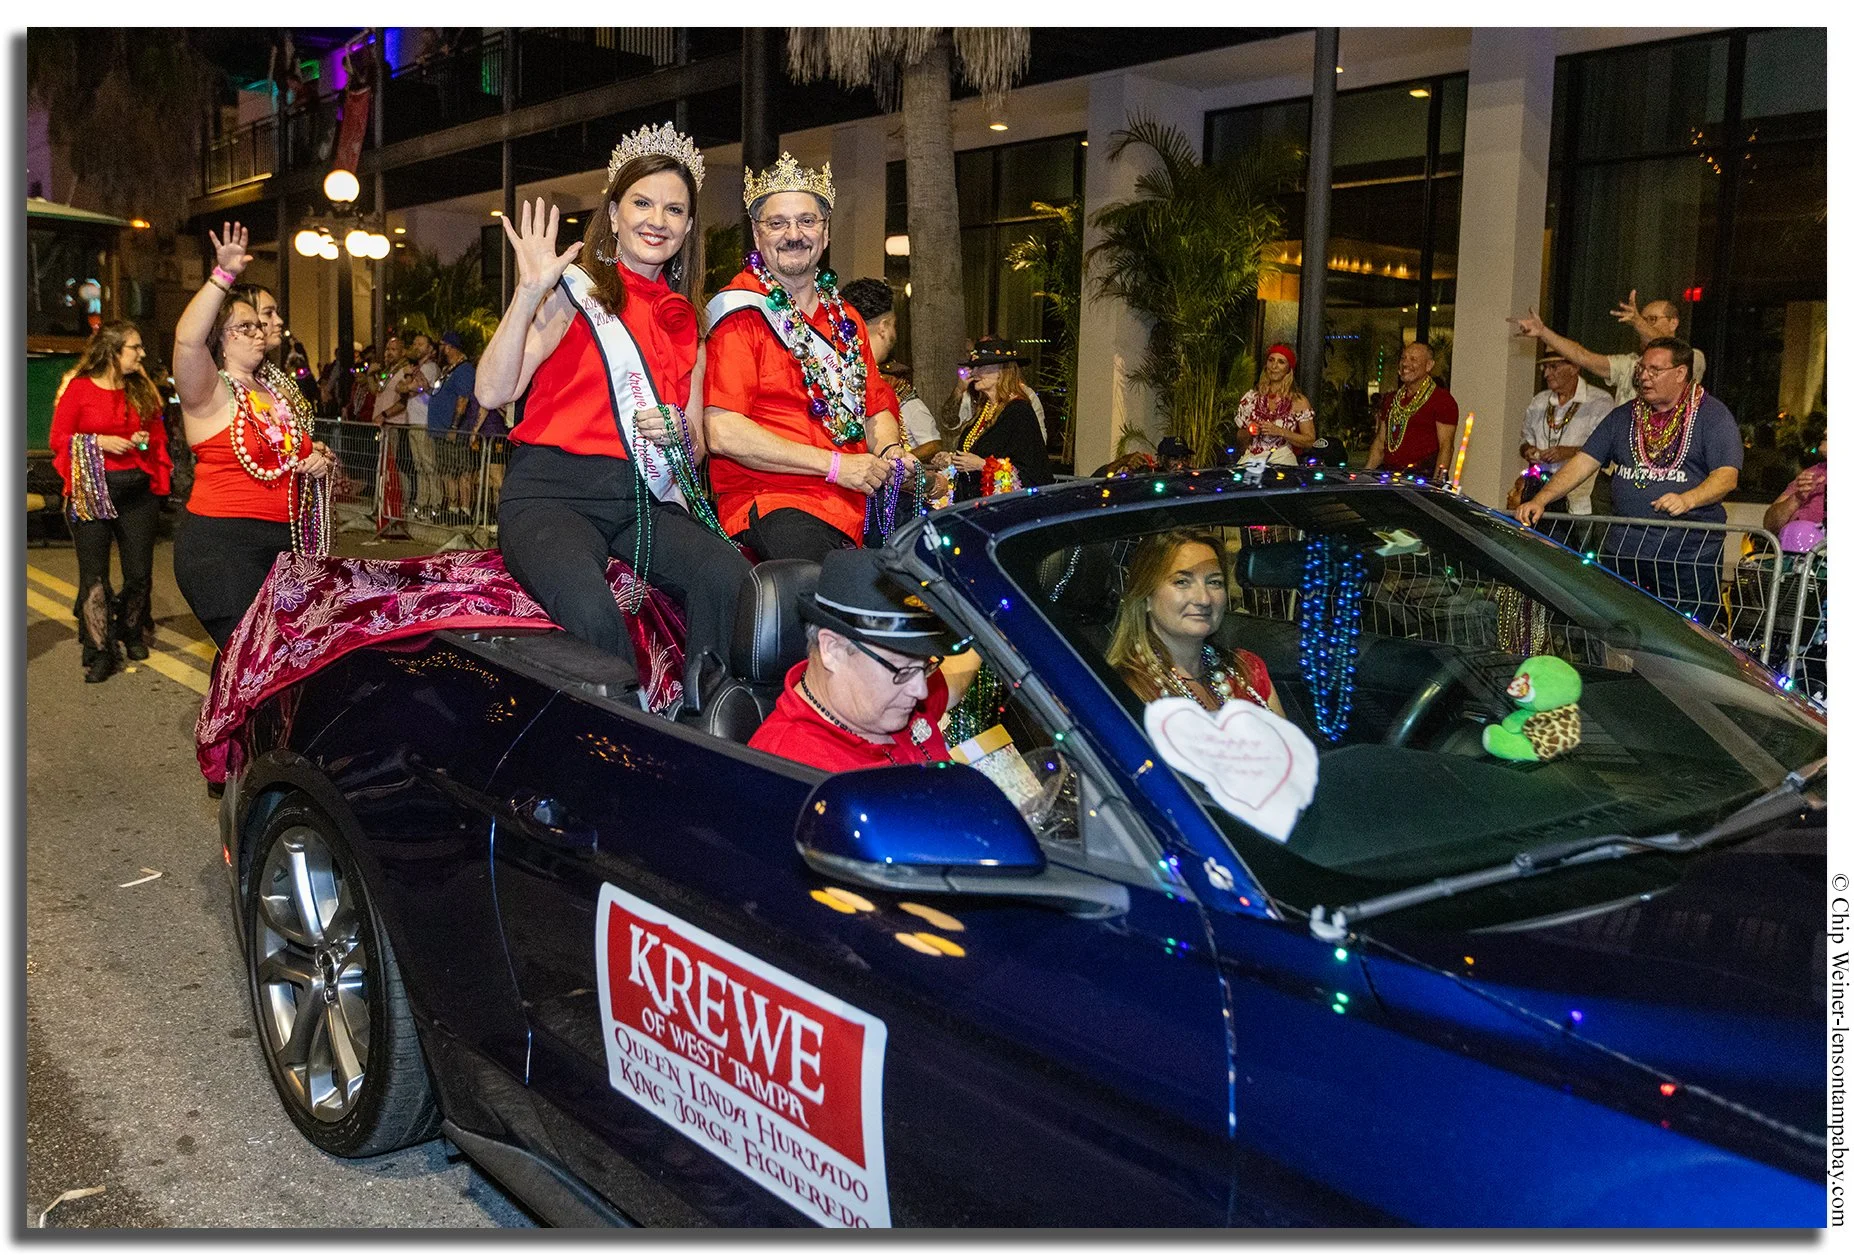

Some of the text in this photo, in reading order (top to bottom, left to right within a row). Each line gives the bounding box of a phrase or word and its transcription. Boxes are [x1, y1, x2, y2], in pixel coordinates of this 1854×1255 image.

[582, 296, 601, 310] 202
[627, 371, 647, 408] Krewe
[628, 923, 825, 1105] KREWE
[641, 1007, 810, 1129] OF WEST TAMPA
